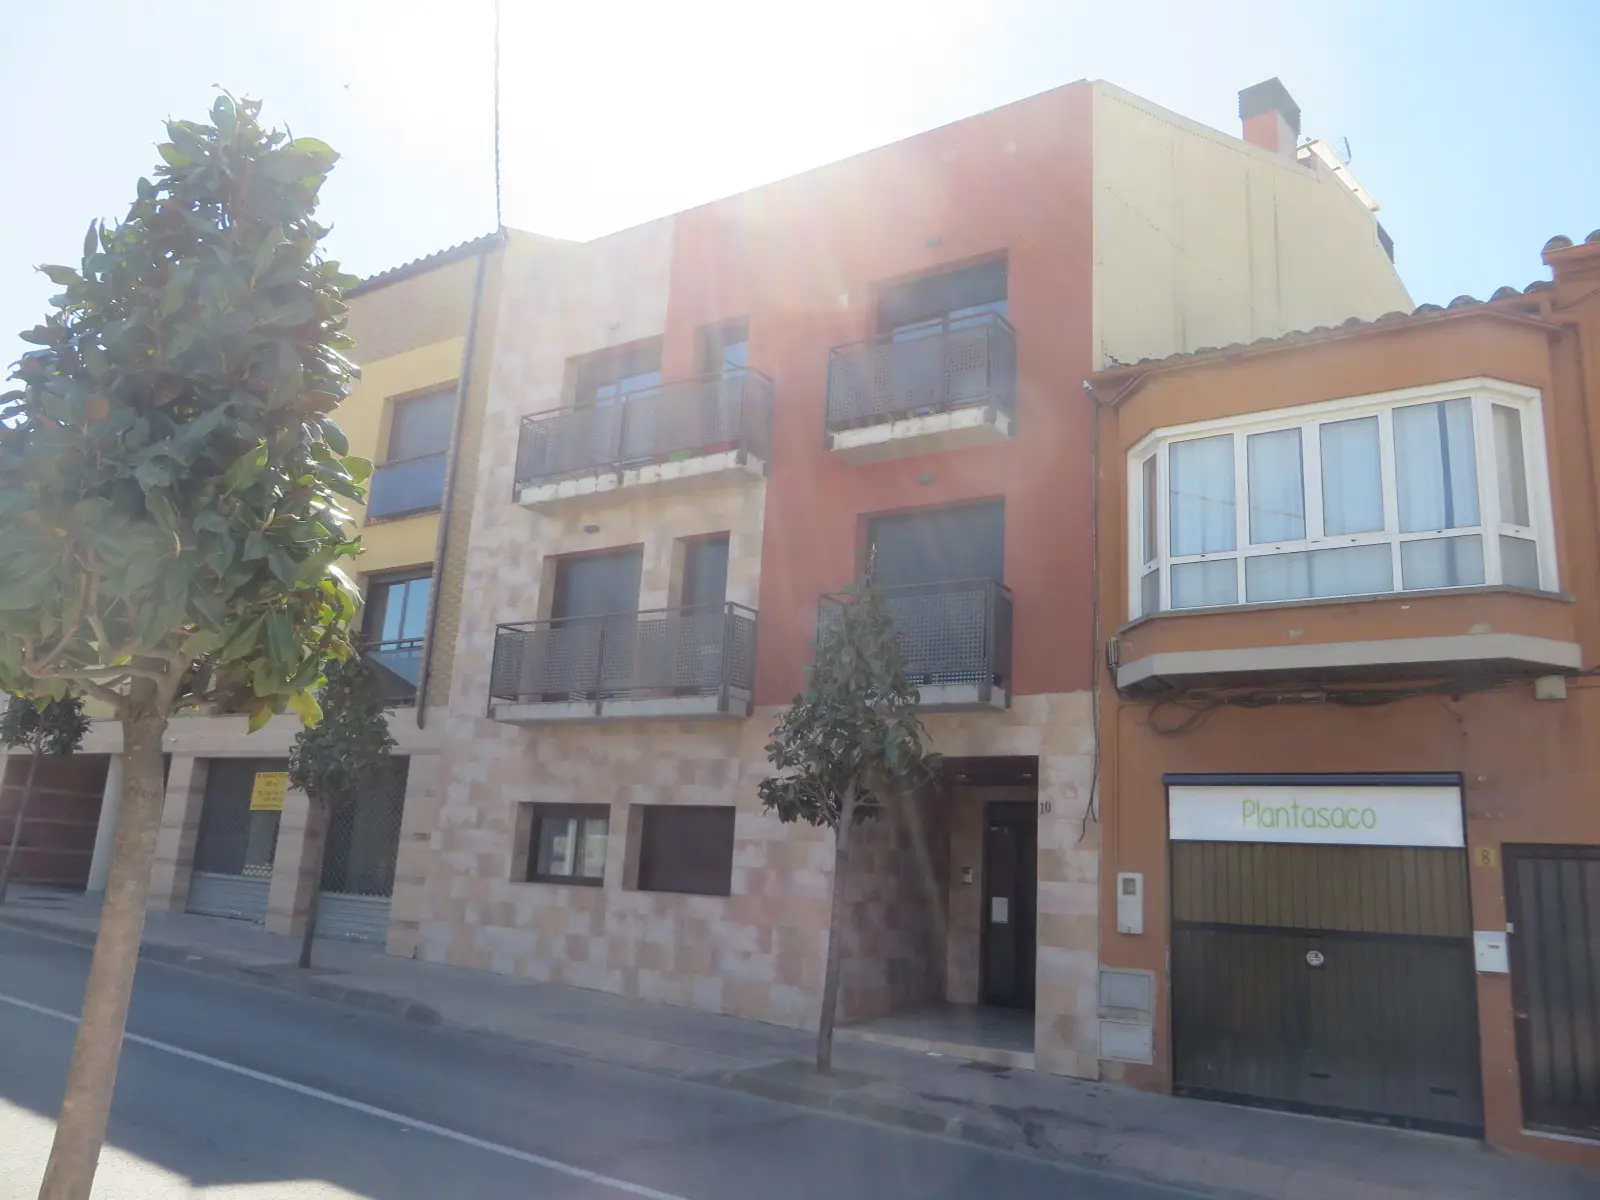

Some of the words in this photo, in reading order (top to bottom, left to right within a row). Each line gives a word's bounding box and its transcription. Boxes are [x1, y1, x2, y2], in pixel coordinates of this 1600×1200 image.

[1040, 800, 1051, 815] 10
[1242, 798, 1377, 830] Plantasaco
[1480, 848, 1491, 865] 8
